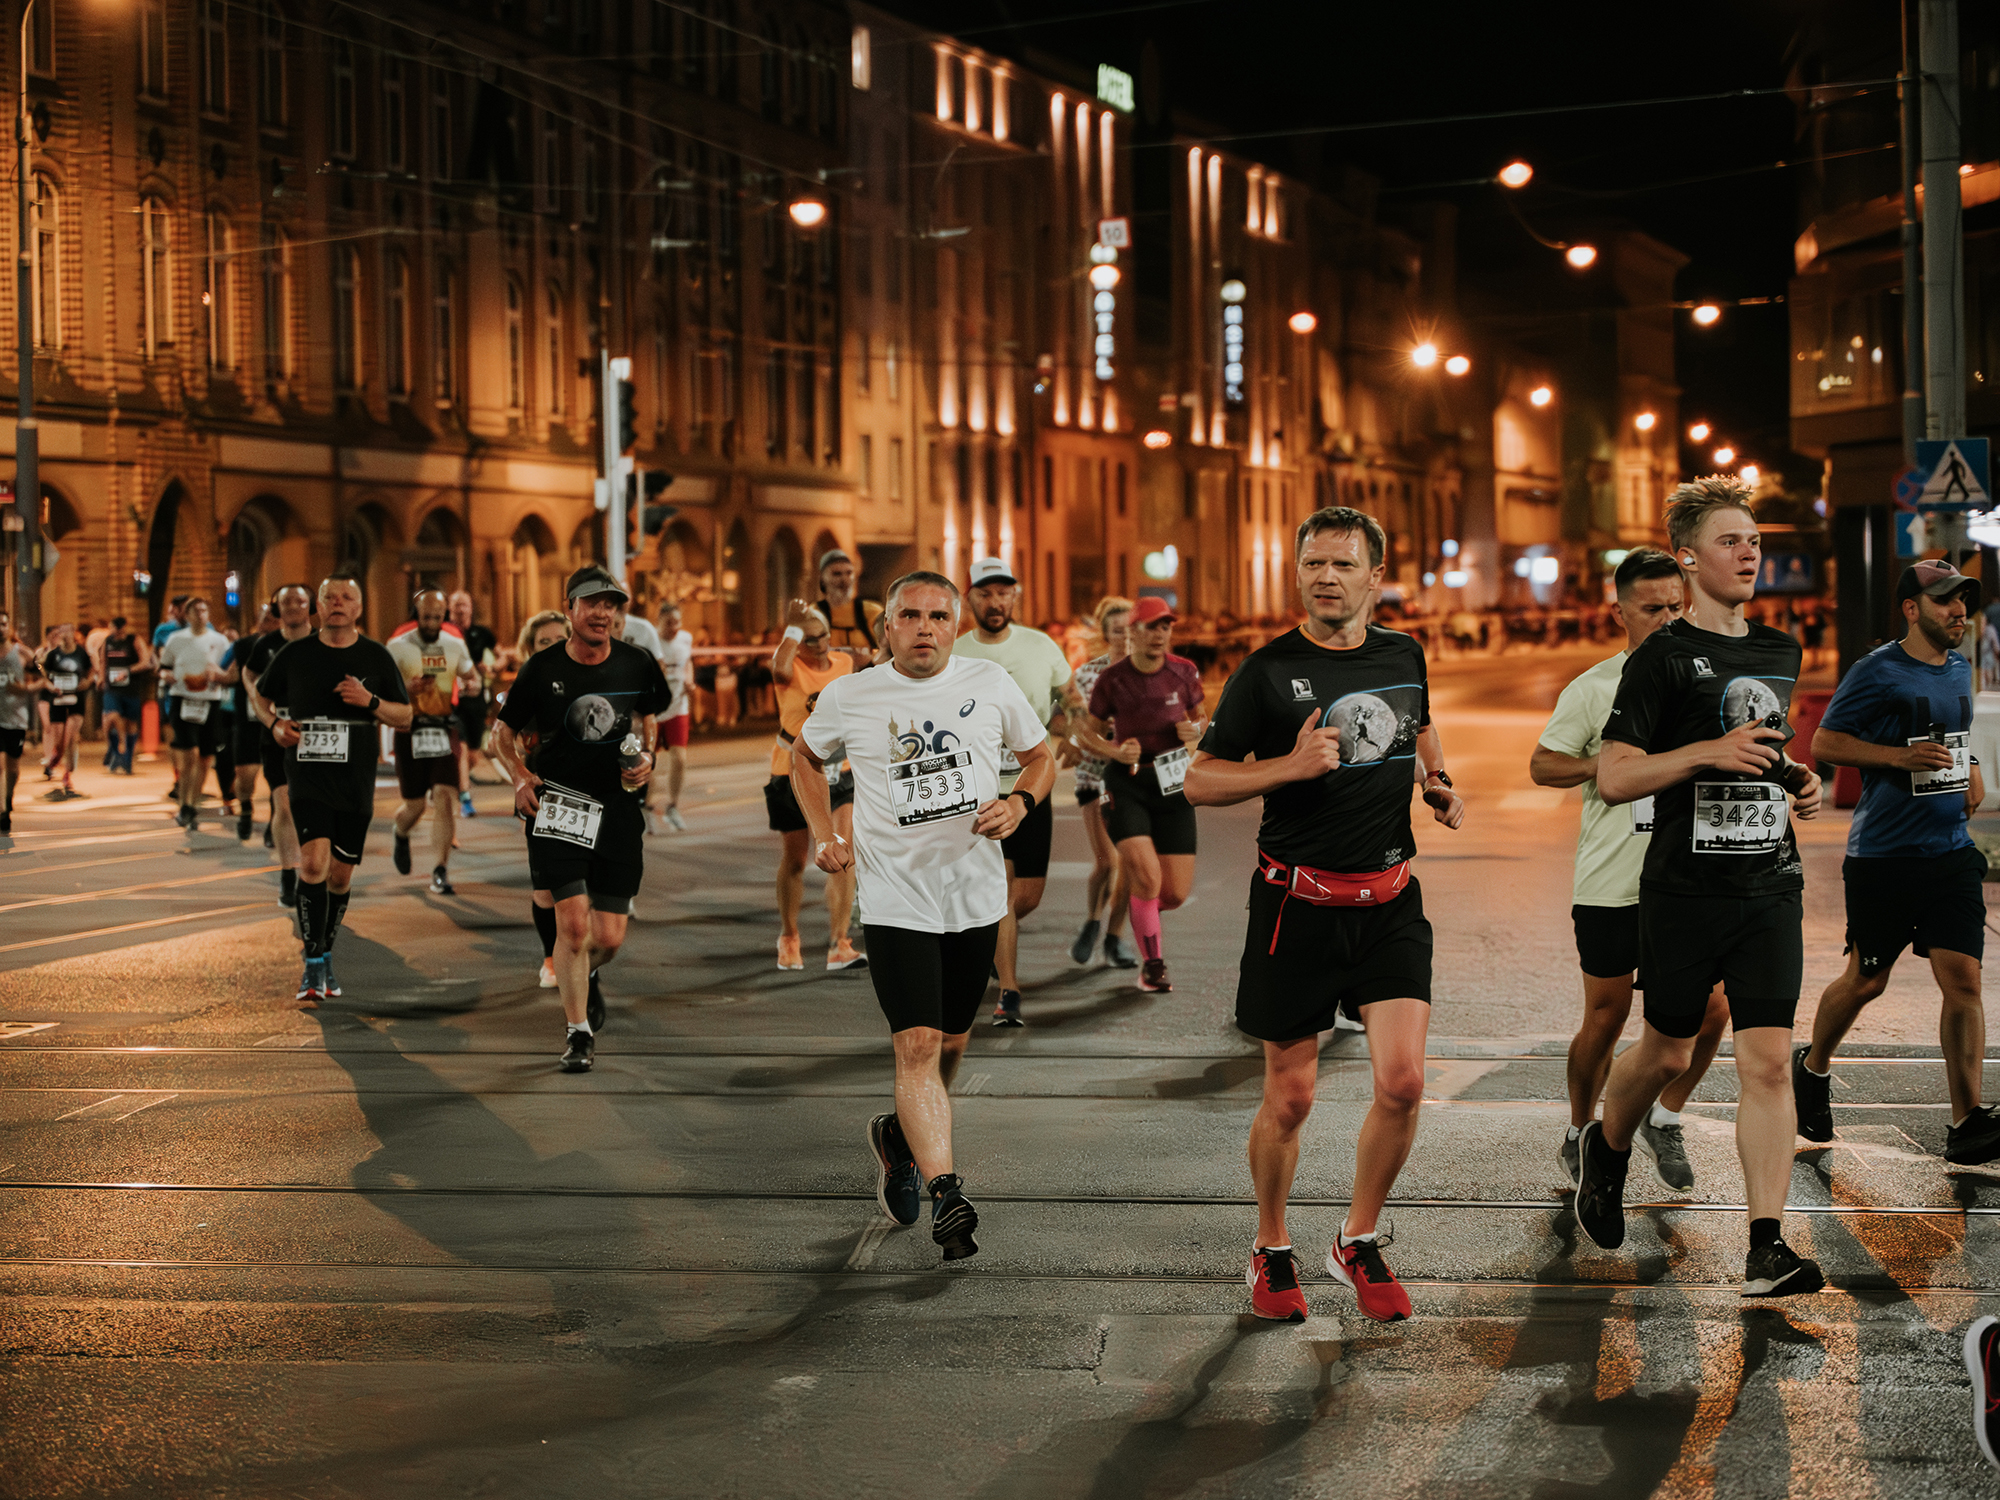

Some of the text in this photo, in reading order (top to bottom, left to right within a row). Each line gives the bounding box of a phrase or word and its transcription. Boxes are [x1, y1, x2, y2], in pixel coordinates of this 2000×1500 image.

[304, 733, 340, 747] 5739
[902, 771, 965, 803] 7533
[1710, 804, 1777, 827] 3426
